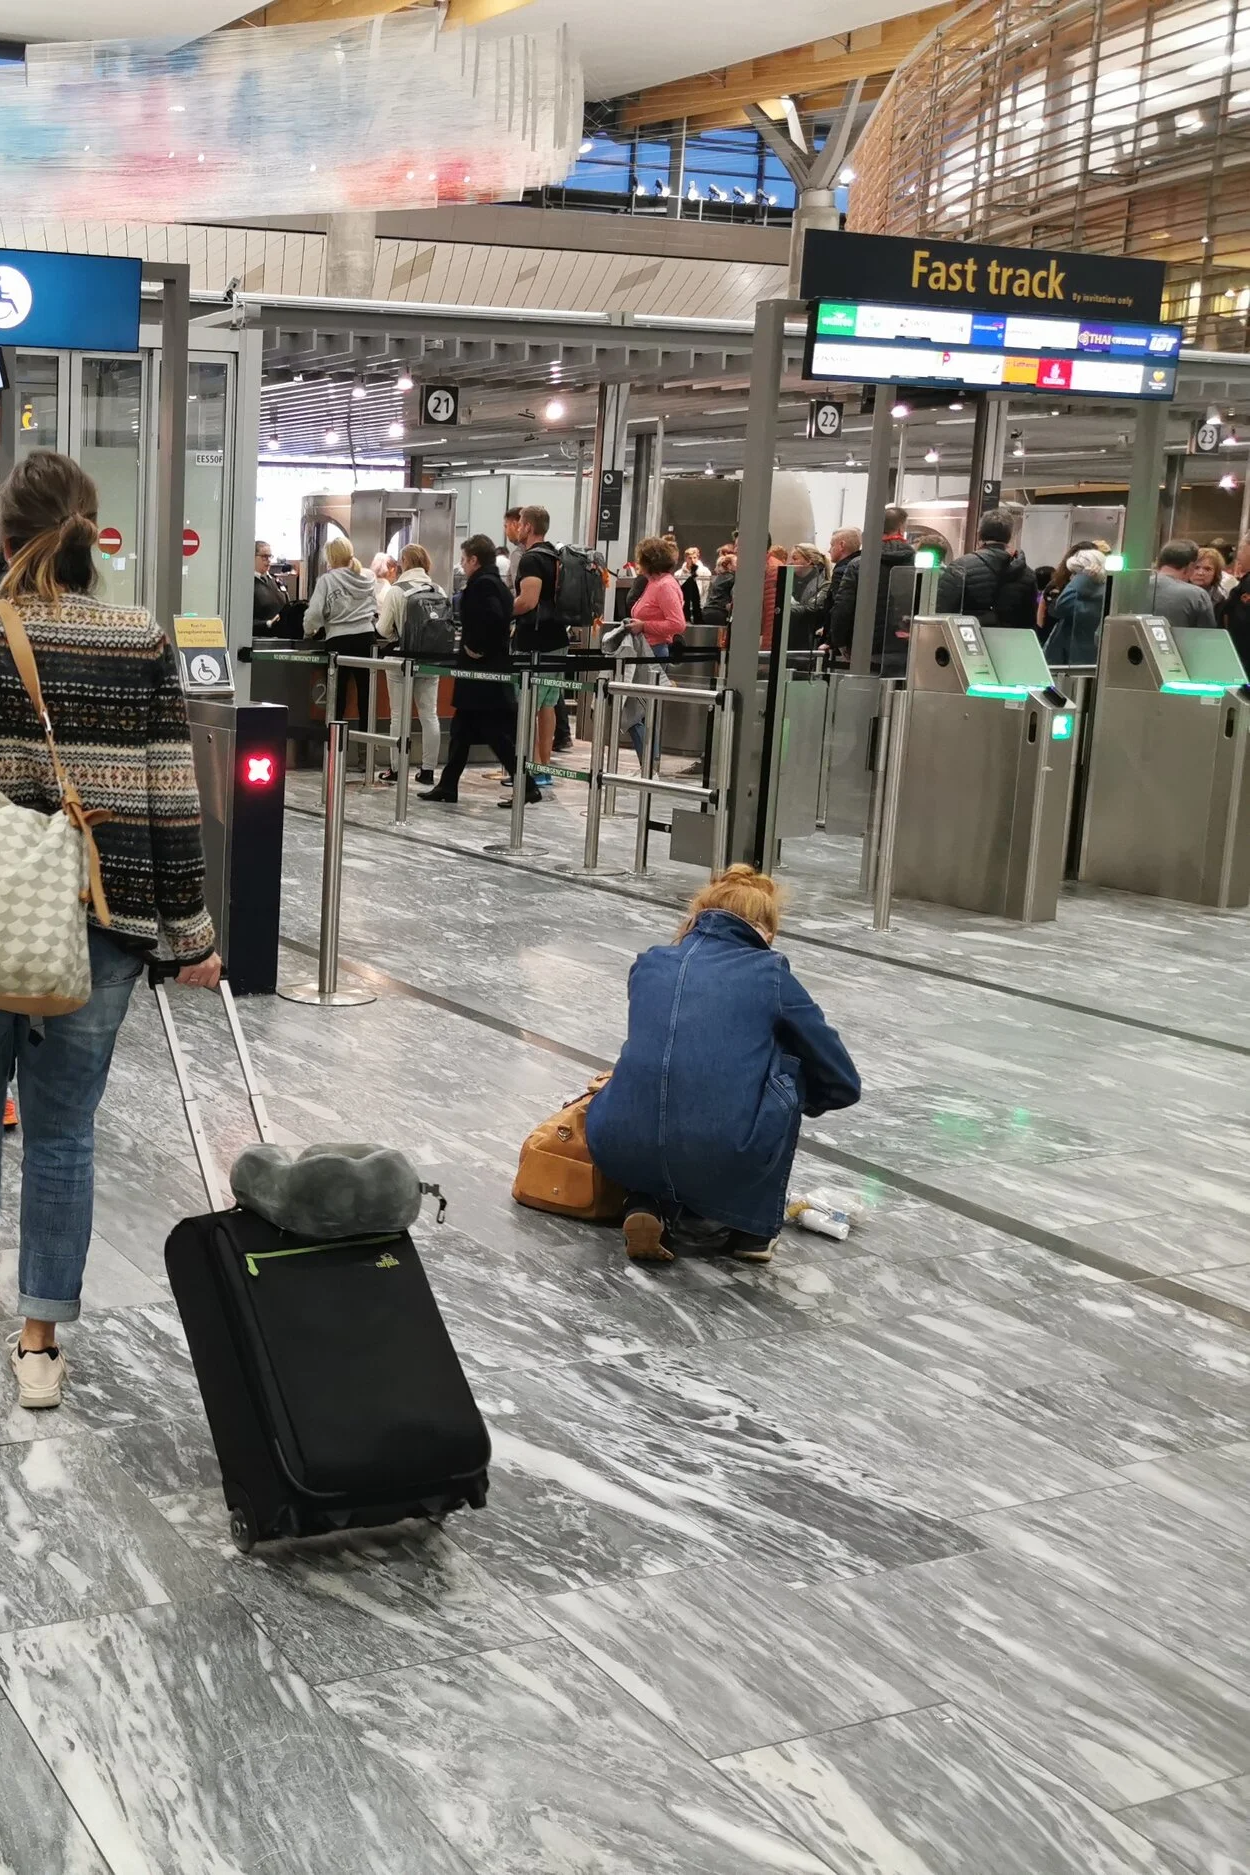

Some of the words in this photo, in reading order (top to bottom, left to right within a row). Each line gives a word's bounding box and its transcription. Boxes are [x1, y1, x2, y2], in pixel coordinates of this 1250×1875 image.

[911, 250, 978, 293] Fast
[987, 259, 1066, 300] track
[1072, 292, 1082, 303] By
[1082, 293, 1117, 304] invitation
[1117, 296, 1134, 307] only
[1090, 334, 1112, 346] THAI
[432, 396, 450, 414] 21
[821, 411, 837, 427] 22
[1201, 429, 1215, 444] 23
[450, 669, 458, 677] NO
[473, 672, 501, 681] EMERGENCY
[544, 678, 571, 688] EMERGENCY
[536, 764, 566, 777] EMERGENCY
[566, 769, 577, 778] EXIT
